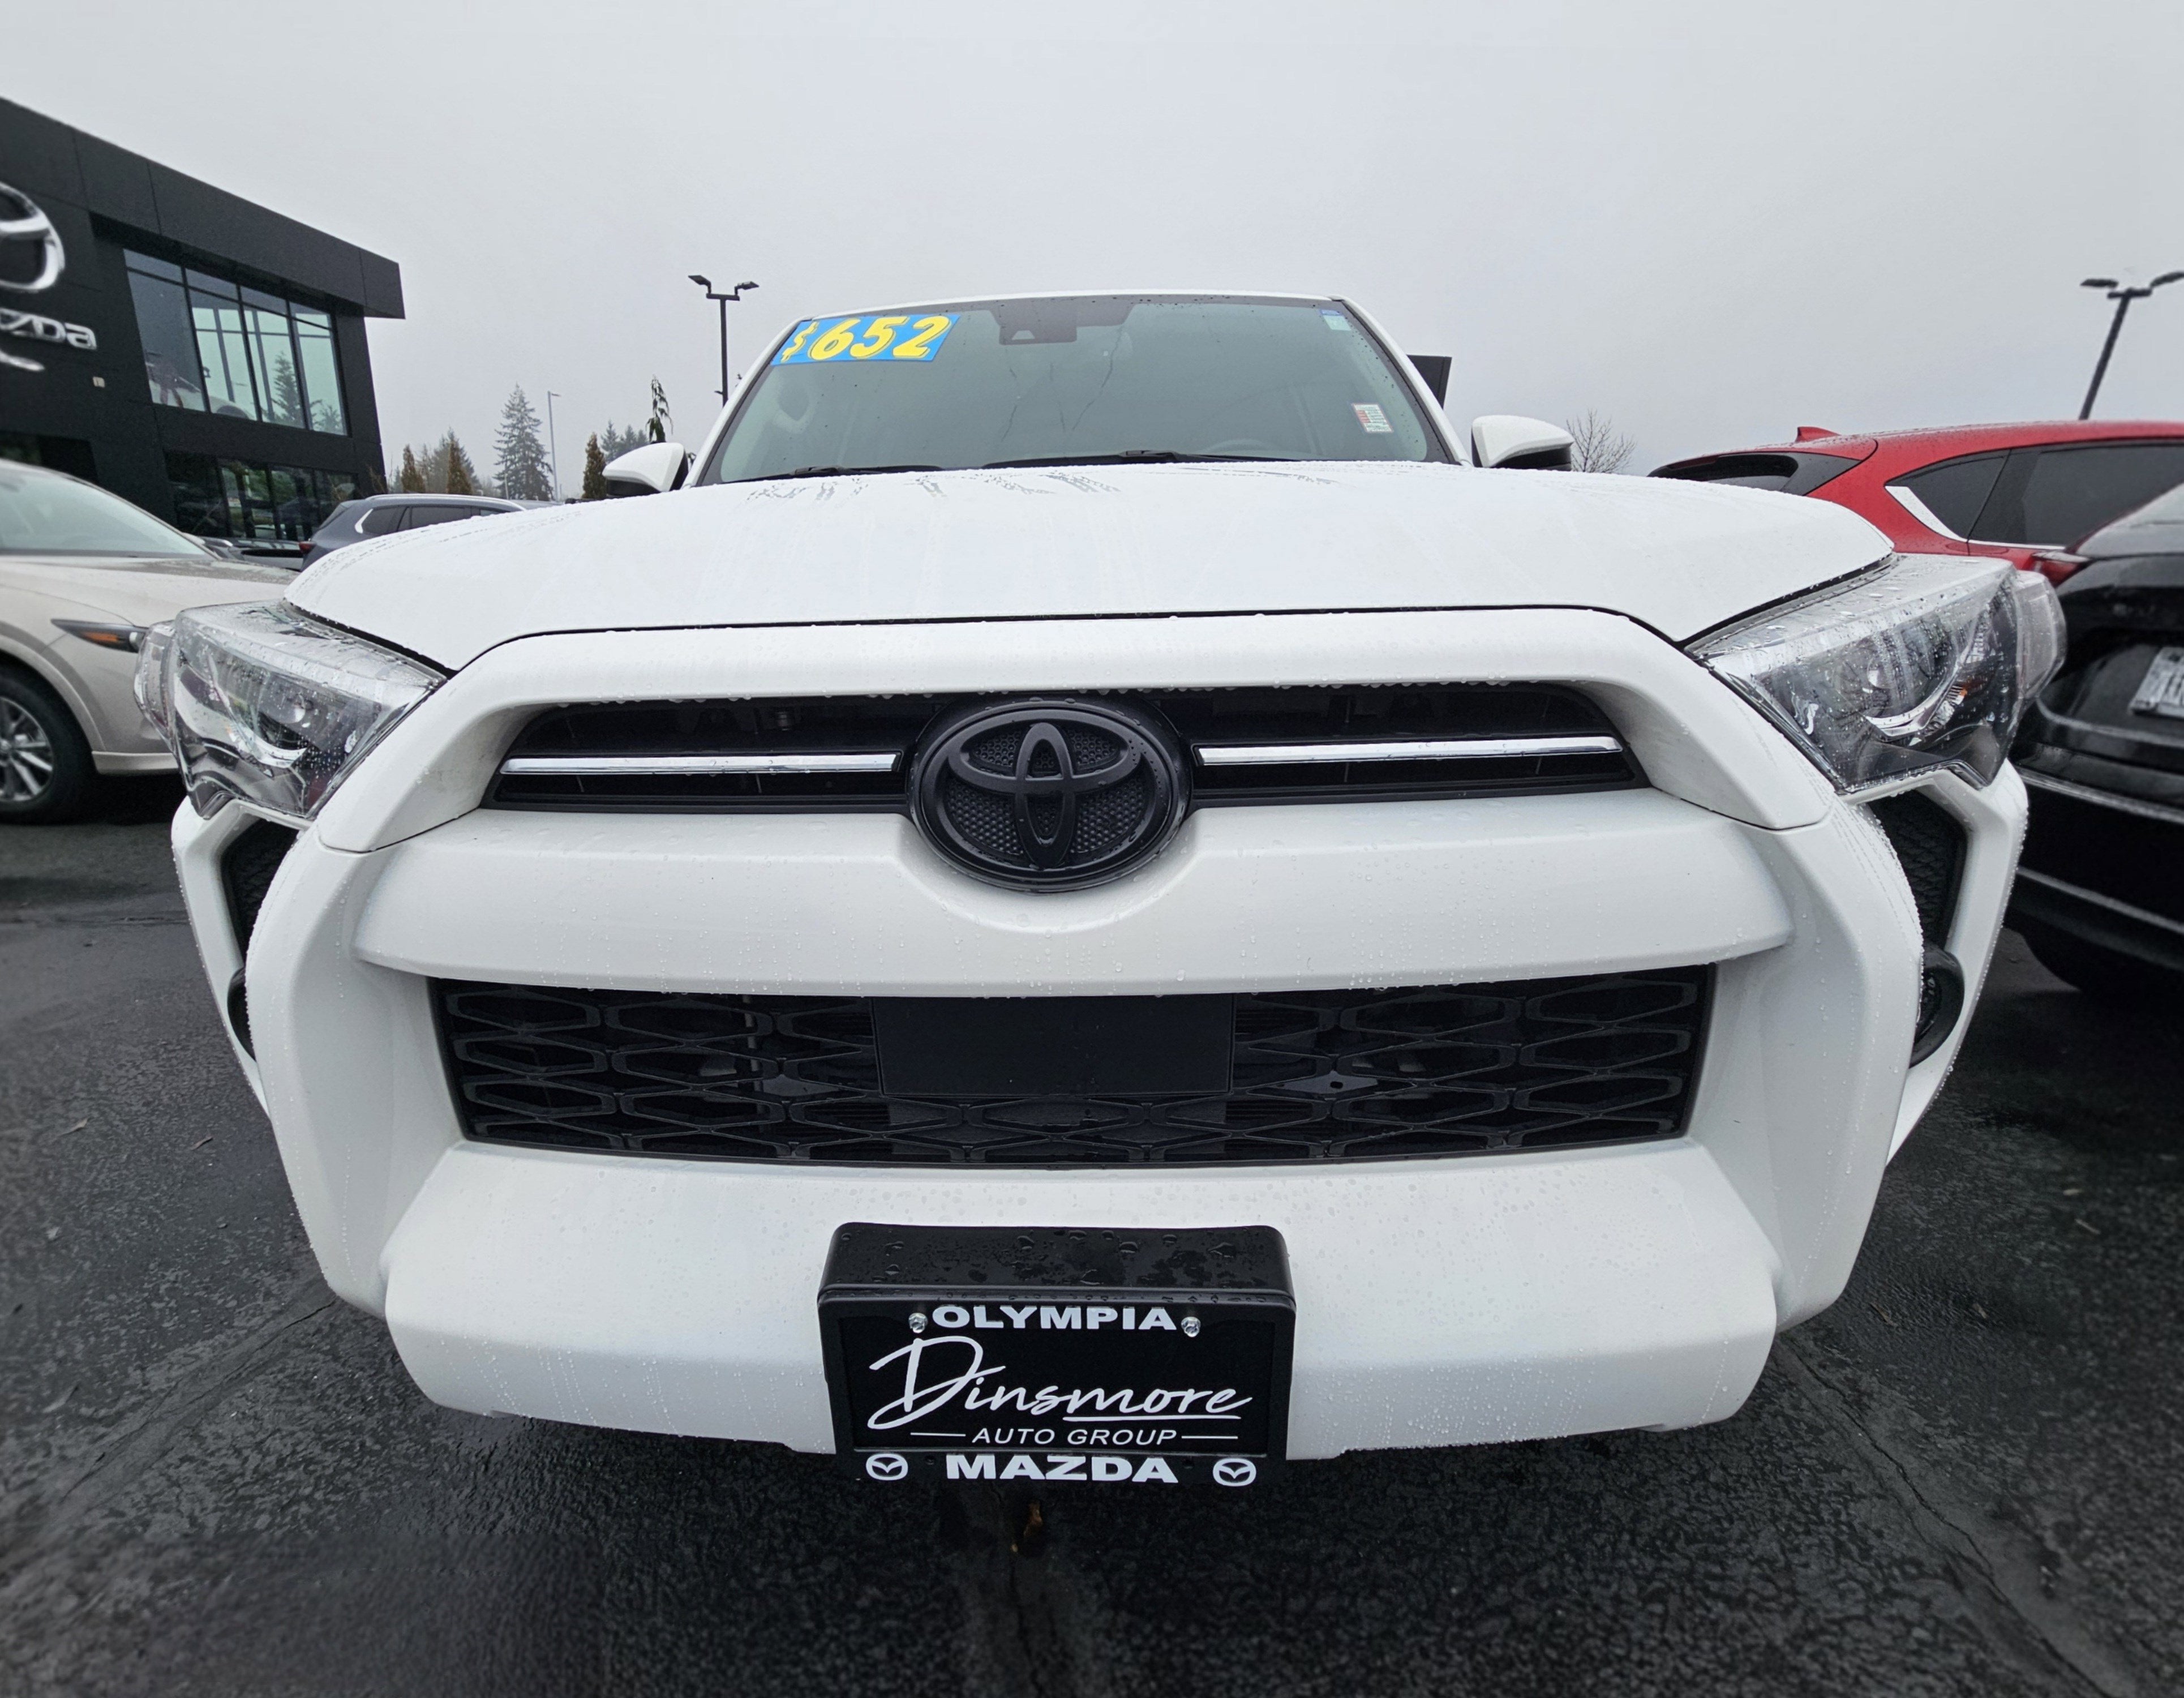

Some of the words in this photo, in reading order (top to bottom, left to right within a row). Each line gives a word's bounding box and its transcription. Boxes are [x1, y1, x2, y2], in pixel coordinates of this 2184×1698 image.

[781, 315, 951, 362] $652
[932, 1305, 1177, 1331] OLYMPIA
[867, 1335, 1253, 1430] Dinsmore
[971, 1427, 1055, 1445] AUTO
[1067, 1429, 1177, 1446] GROUP
[945, 1454, 1179, 1483] MAZDA
